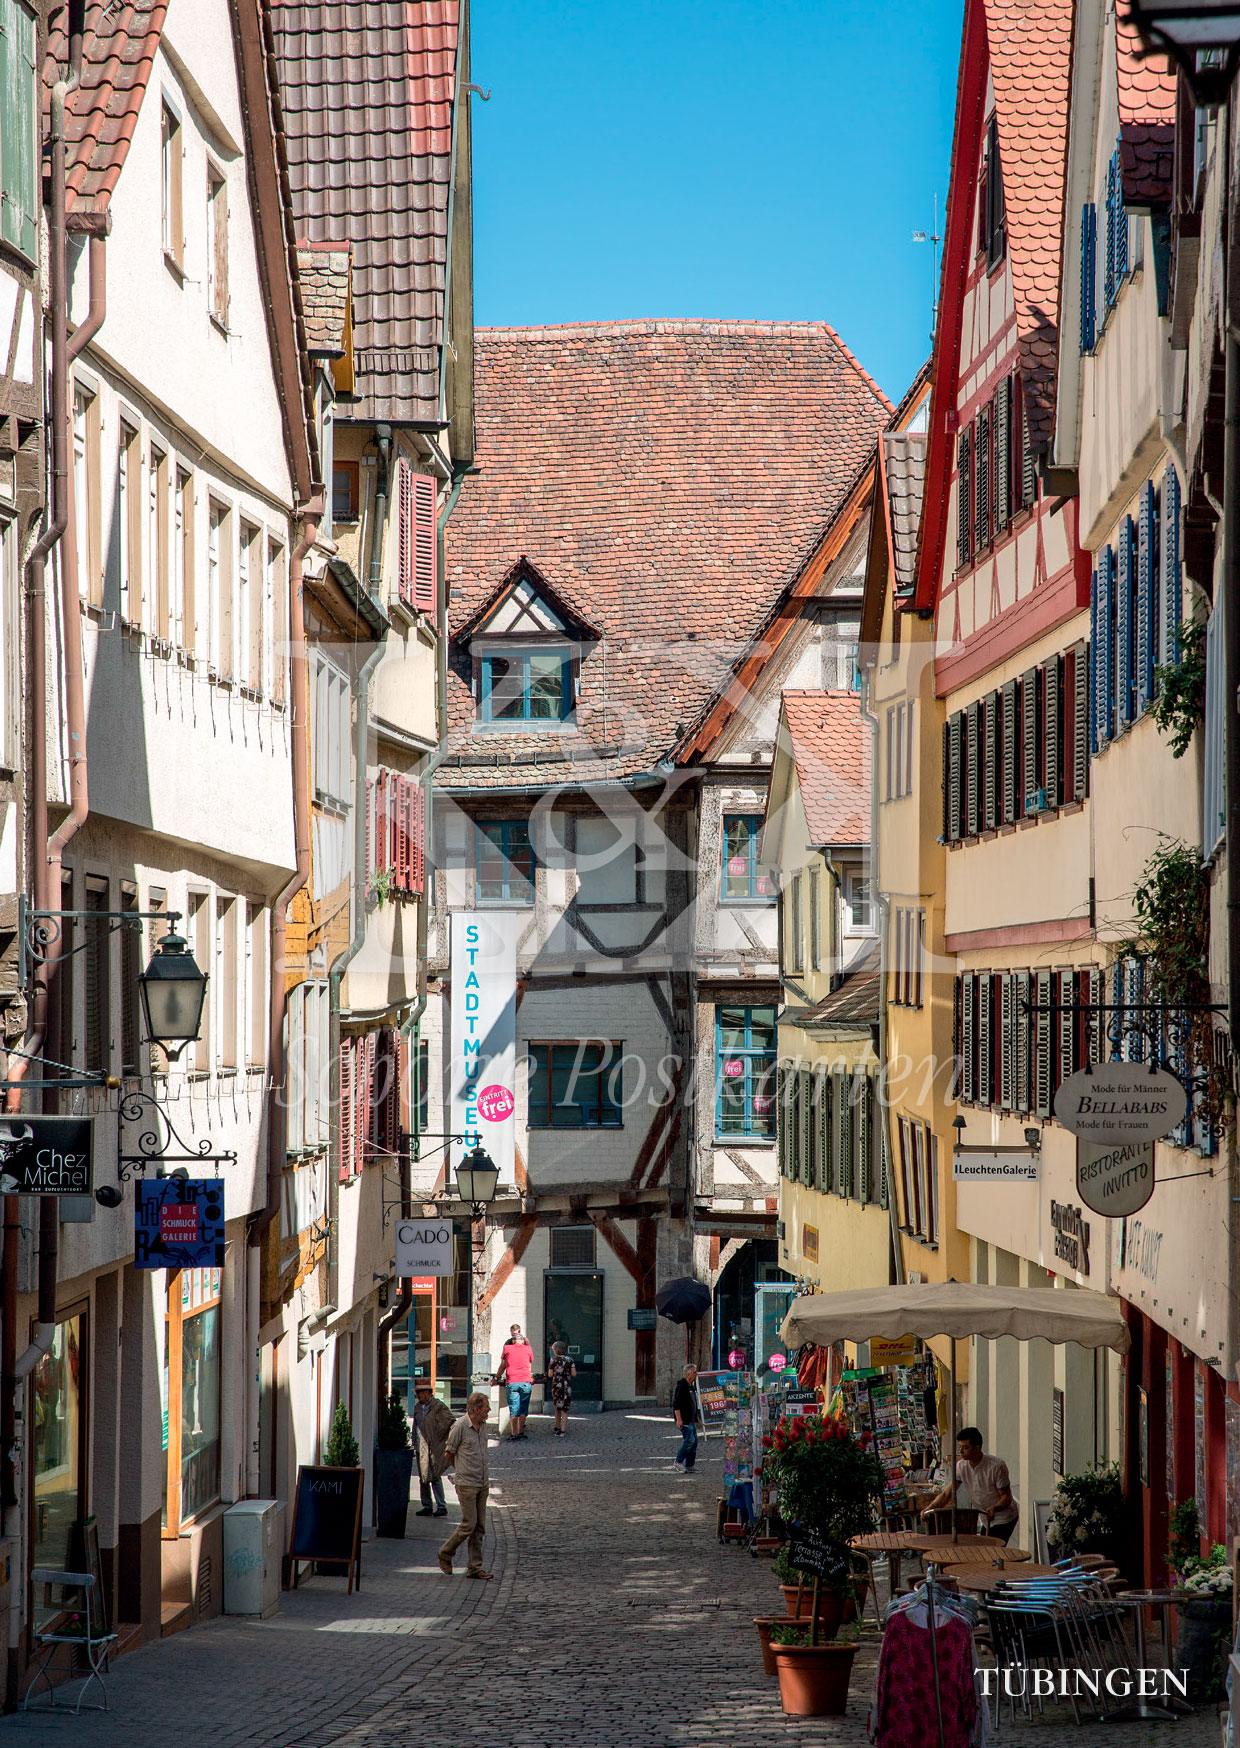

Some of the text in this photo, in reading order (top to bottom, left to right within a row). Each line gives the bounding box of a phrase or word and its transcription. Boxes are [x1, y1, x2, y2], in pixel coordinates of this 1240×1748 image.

[463, 925, 480, 1158] STADTMUSEU
[479, 1089, 508, 1103] EINTRITT
[1092, 1085, 1168, 1093] Mode für Männer
[482, 1095, 512, 1119] frei
[1076, 1096, 1168, 1114] BELLABABS
[1076, 1120, 1149, 1129] Mode für Frauen
[36, 1149, 87, 1168] Chez
[24, 1166, 87, 1186] Michel
[959, 1164, 1037, 1175] LeuchtenGalerie
[1102, 1162, 1148, 1198] INVITTO
[162, 1206, 197, 1215] DIE
[162, 1219, 196, 1228] SCHMUCK
[162, 1232, 197, 1241] GALERIE
[398, 1225, 450, 1245] CADÓ
[787, 1392, 814, 1400] AKZENTE
[710, 1401, 726, 1409] 196
[309, 1480, 342, 1494] KAMI
